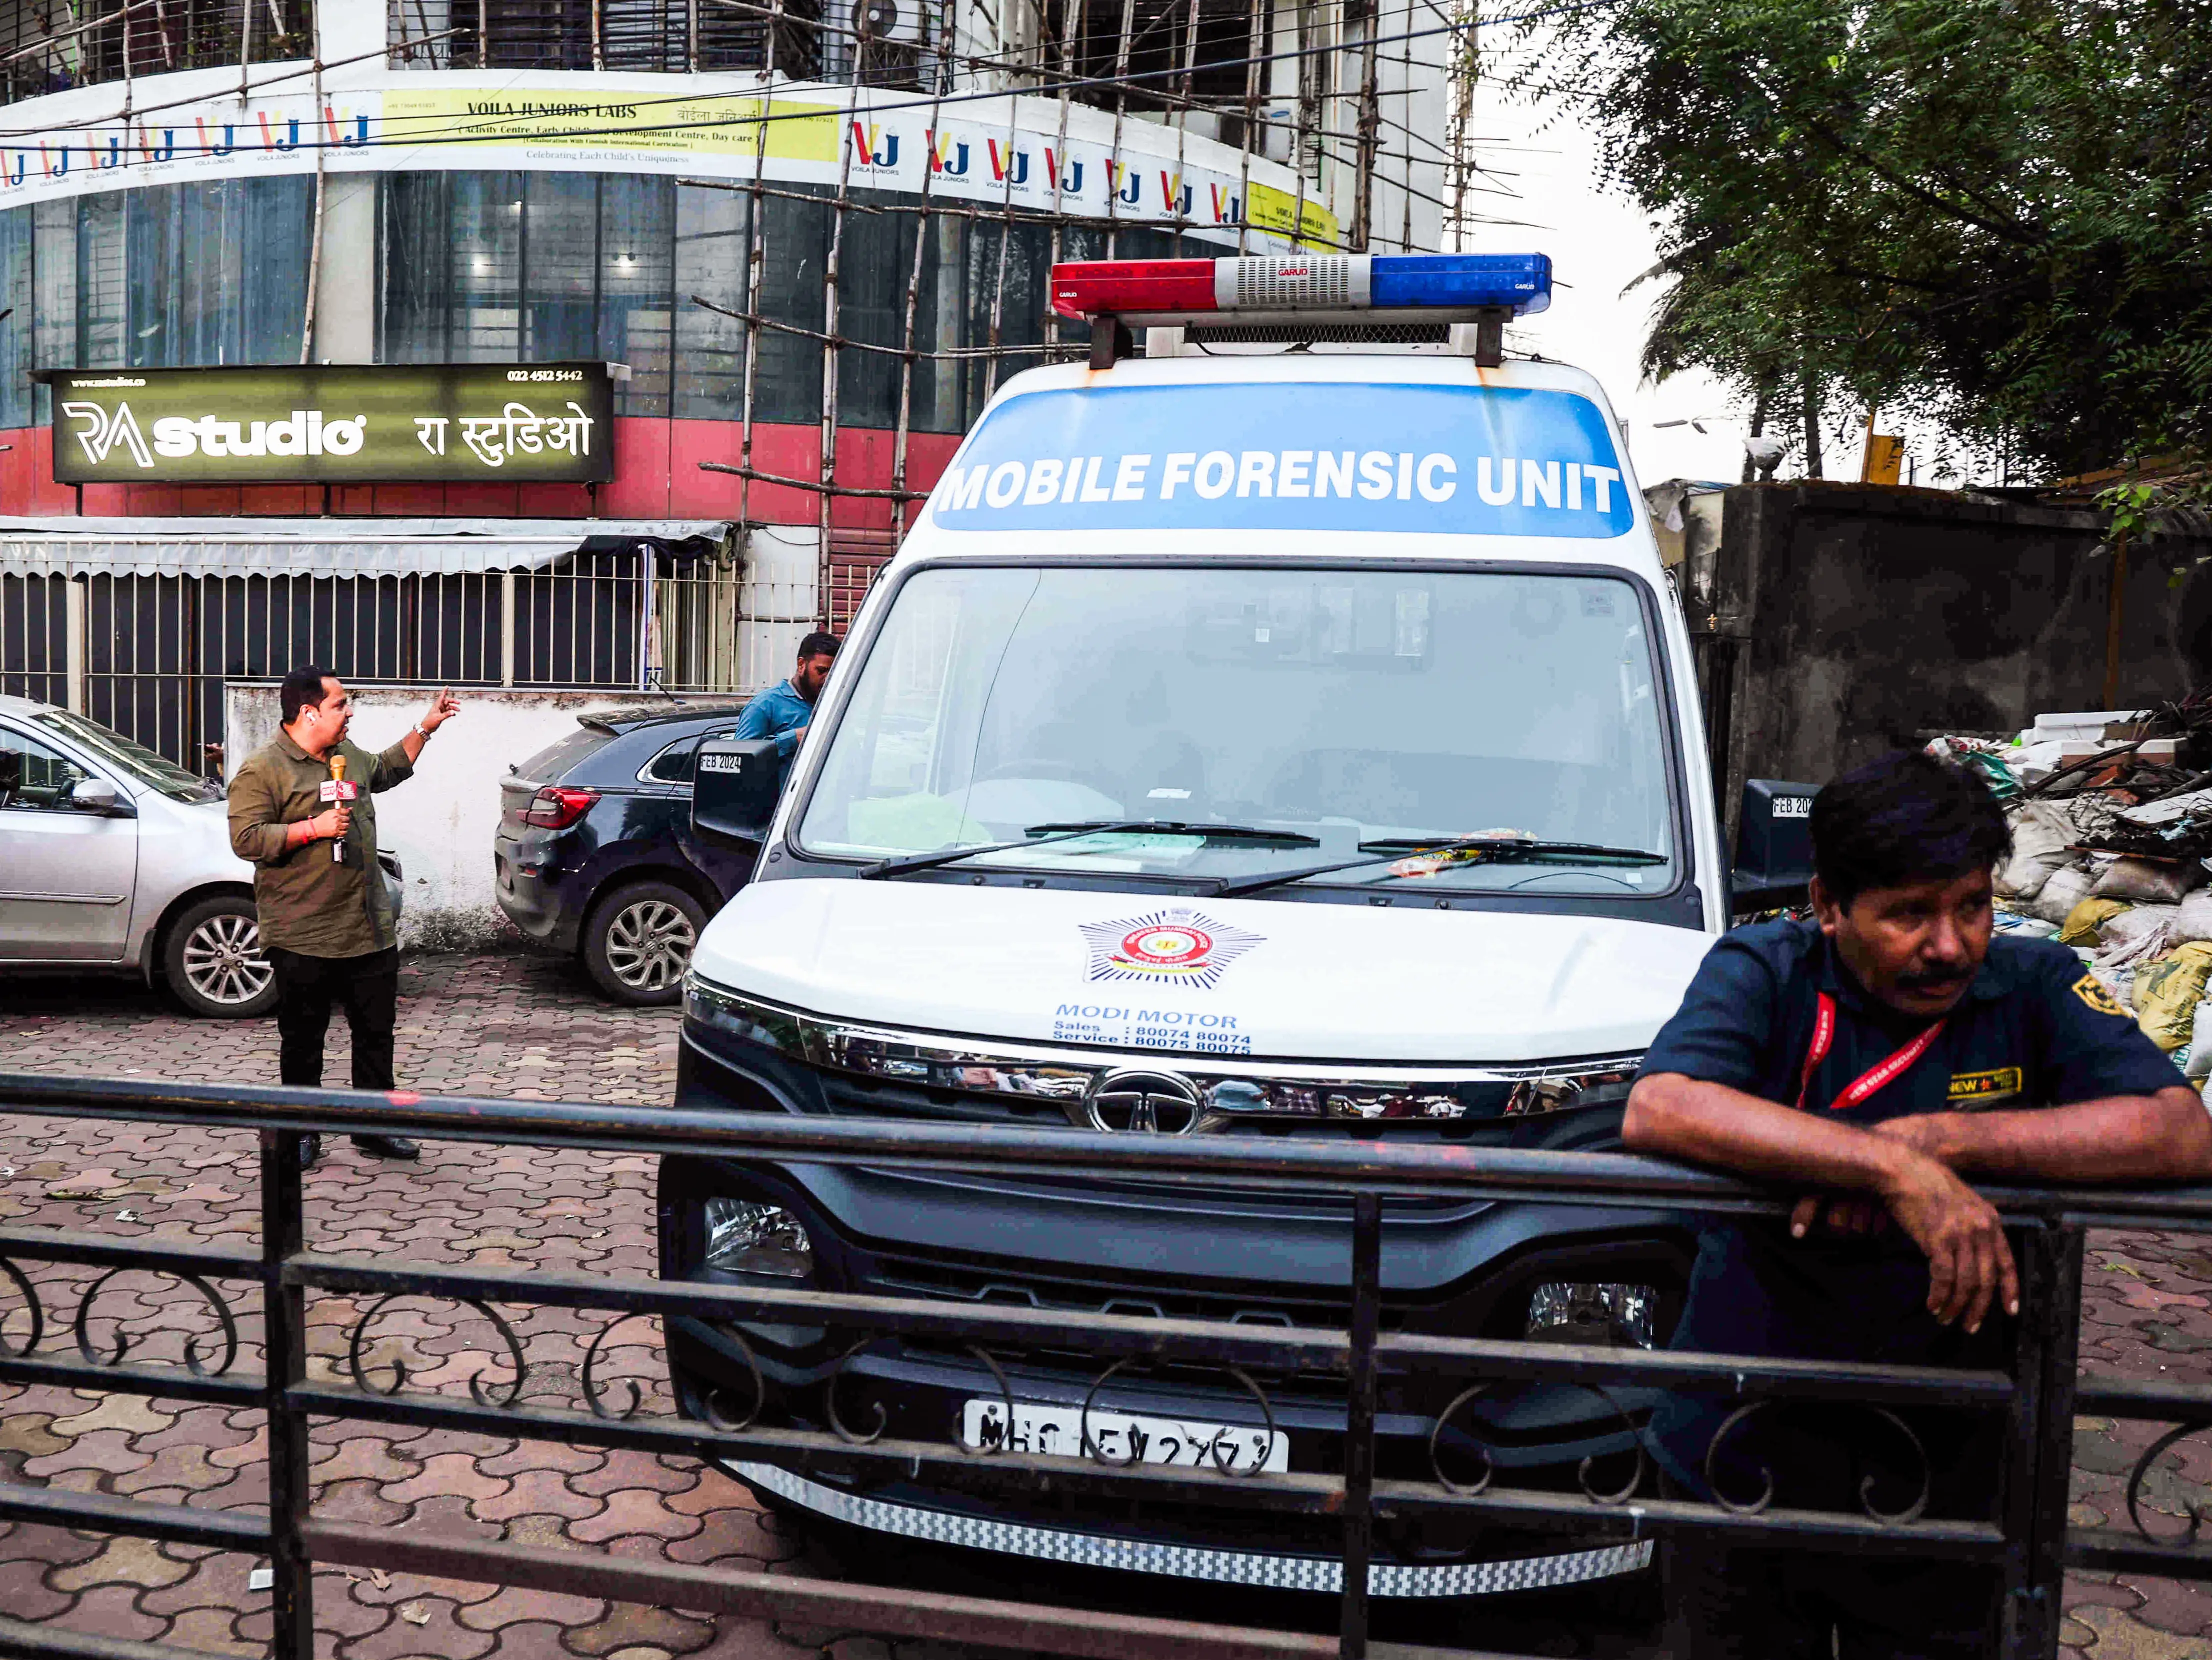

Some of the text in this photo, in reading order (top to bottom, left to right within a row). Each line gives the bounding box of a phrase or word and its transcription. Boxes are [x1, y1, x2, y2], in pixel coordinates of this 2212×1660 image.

[468, 102, 636, 119] VOILA JUNIORS LABS
[465, 125, 496, 134] Activity
[676, 130, 709, 141] Centre,
[712, 132, 728, 143] Day
[852, 122, 900, 167] VJ
[526, 150, 576, 160] Celebrating
[580, 151, 601, 159] Each
[925, 129, 970, 175] VJ
[988, 138, 1029, 184] VJ
[1278, 268, 1308, 276] GARUD
[506, 370, 583, 382] 022 4512 5442
[412, 417, 450, 456] रा
[936, 450, 1621, 514] MOBILE FORENSIC UNIT
[720, 755, 742, 770] 2024
[1774, 798, 1792, 813] FEB
[1055, 1003, 1238, 1029] MODI MOTOR
[1052, 1030, 1118, 1043] Service
[1135, 1037, 1190, 1049] 80075
[1196, 1042, 1252, 1055] 80075
[1053, 1020, 1101, 1032] Sales
[1136, 1027, 1190, 1039] 80074
[1196, 1031, 1251, 1045] 80074
